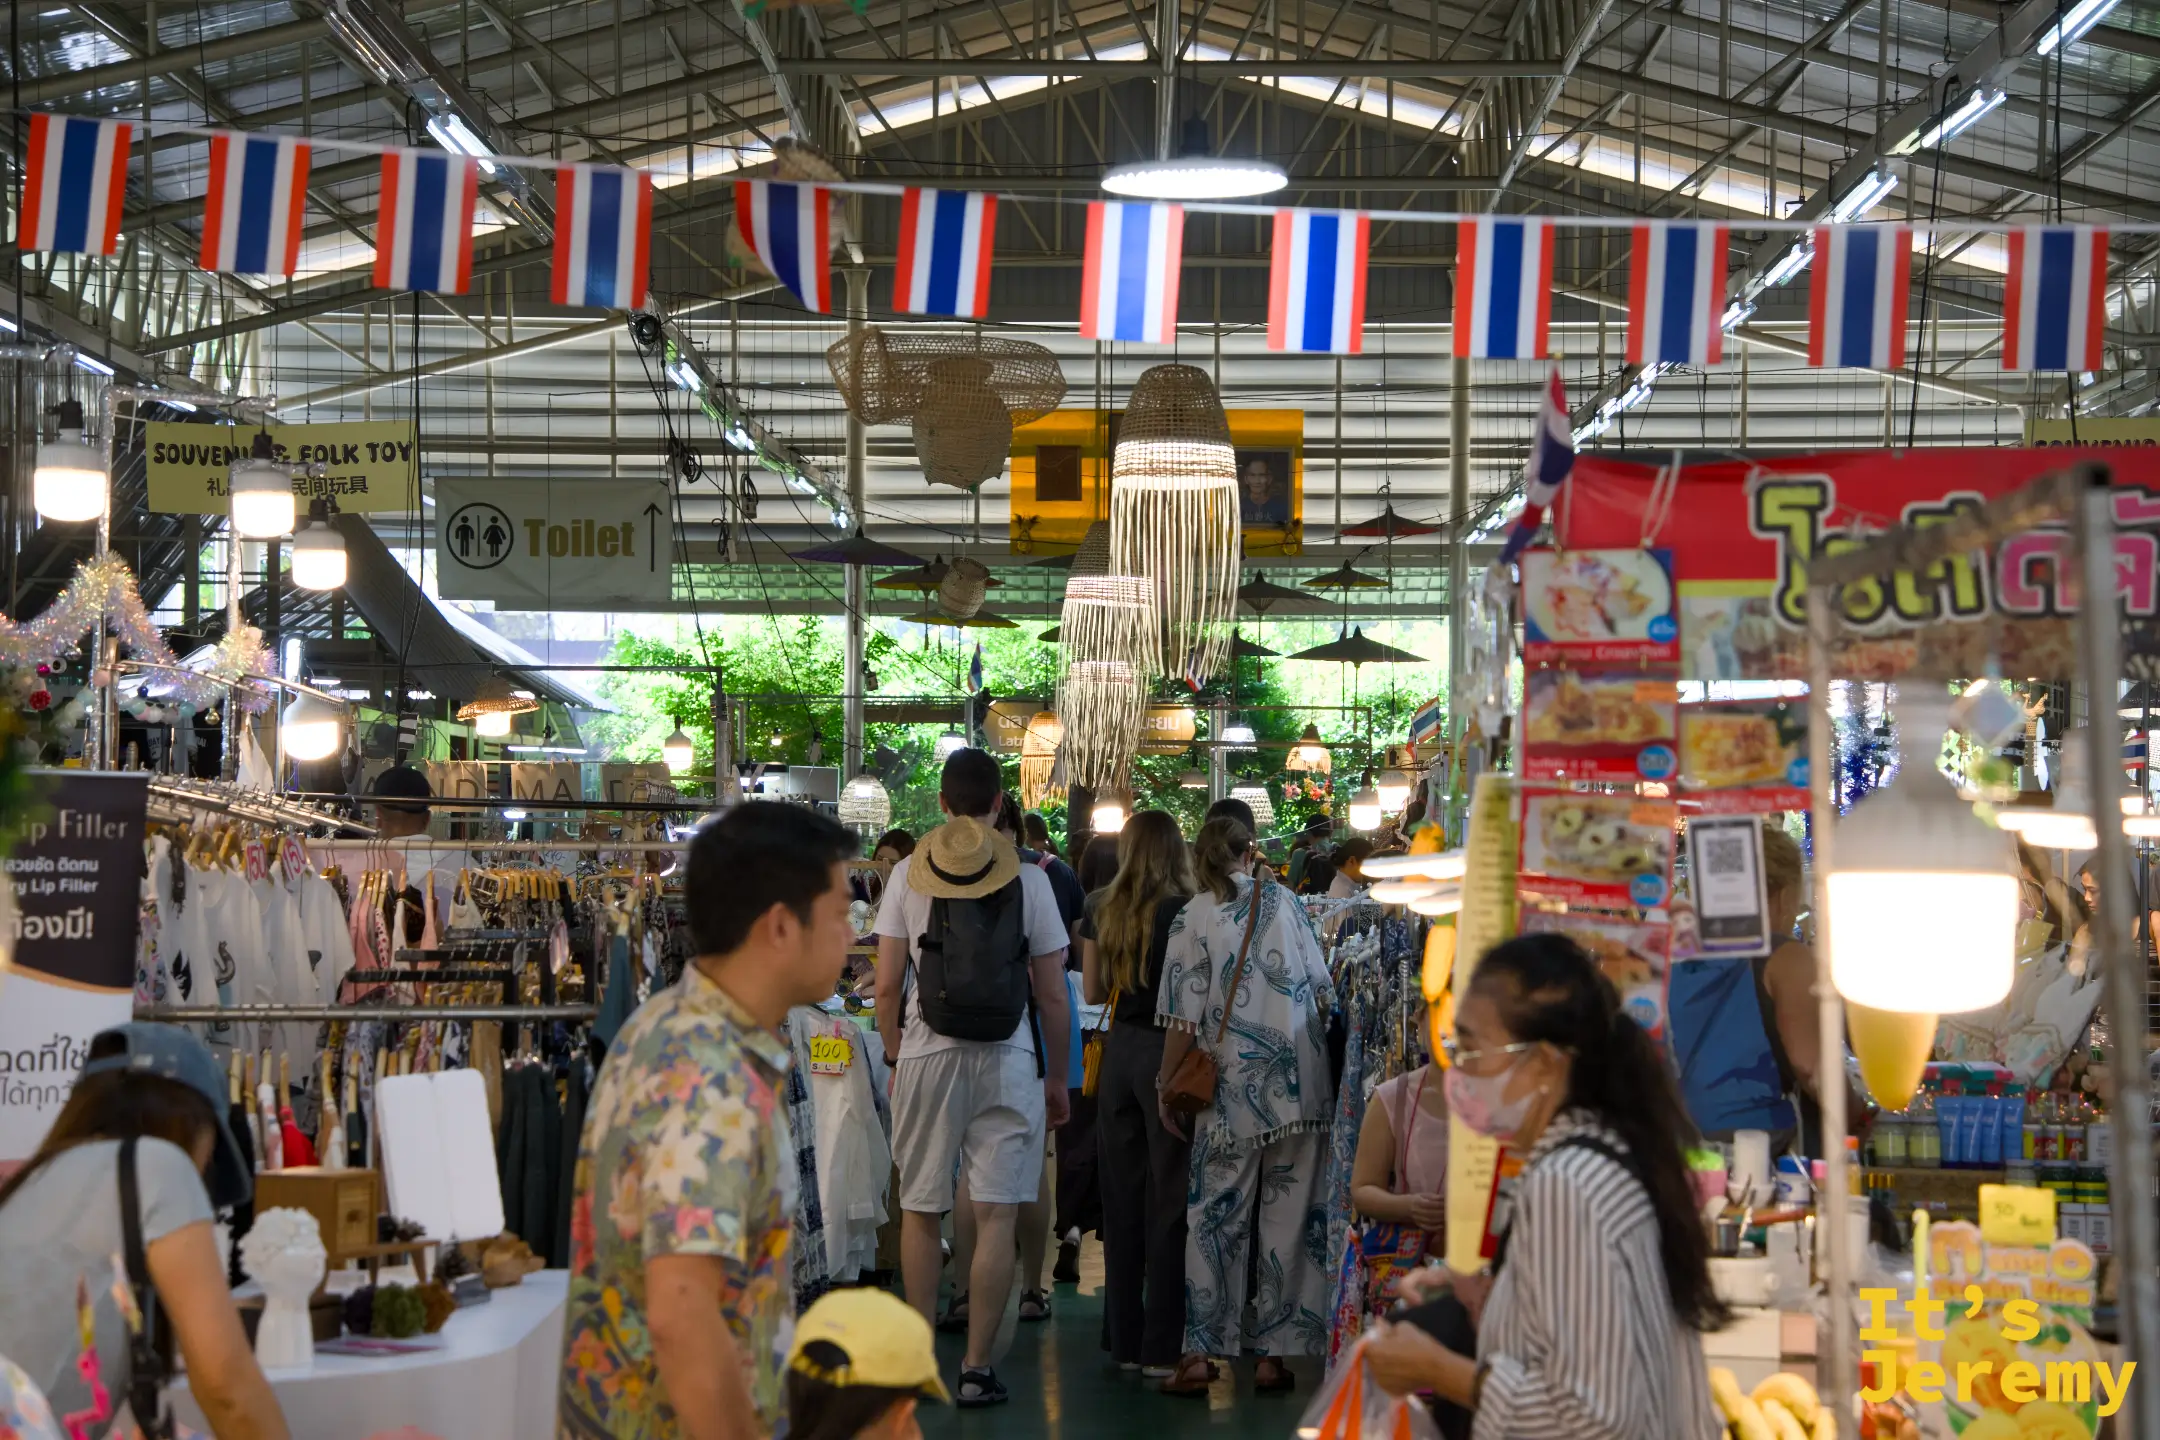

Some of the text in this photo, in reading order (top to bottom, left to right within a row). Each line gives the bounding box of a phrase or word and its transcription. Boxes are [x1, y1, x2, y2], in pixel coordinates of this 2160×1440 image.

[298, 443, 359, 466] FOLK
[366, 440, 413, 463] TOY
[523, 518, 636, 558] Toilet
[58, 809, 128, 839] Filler
[31, 878, 55, 894] Lip
[59, 877, 98, 893] Filler
[813, 1042, 841, 1058] 100
